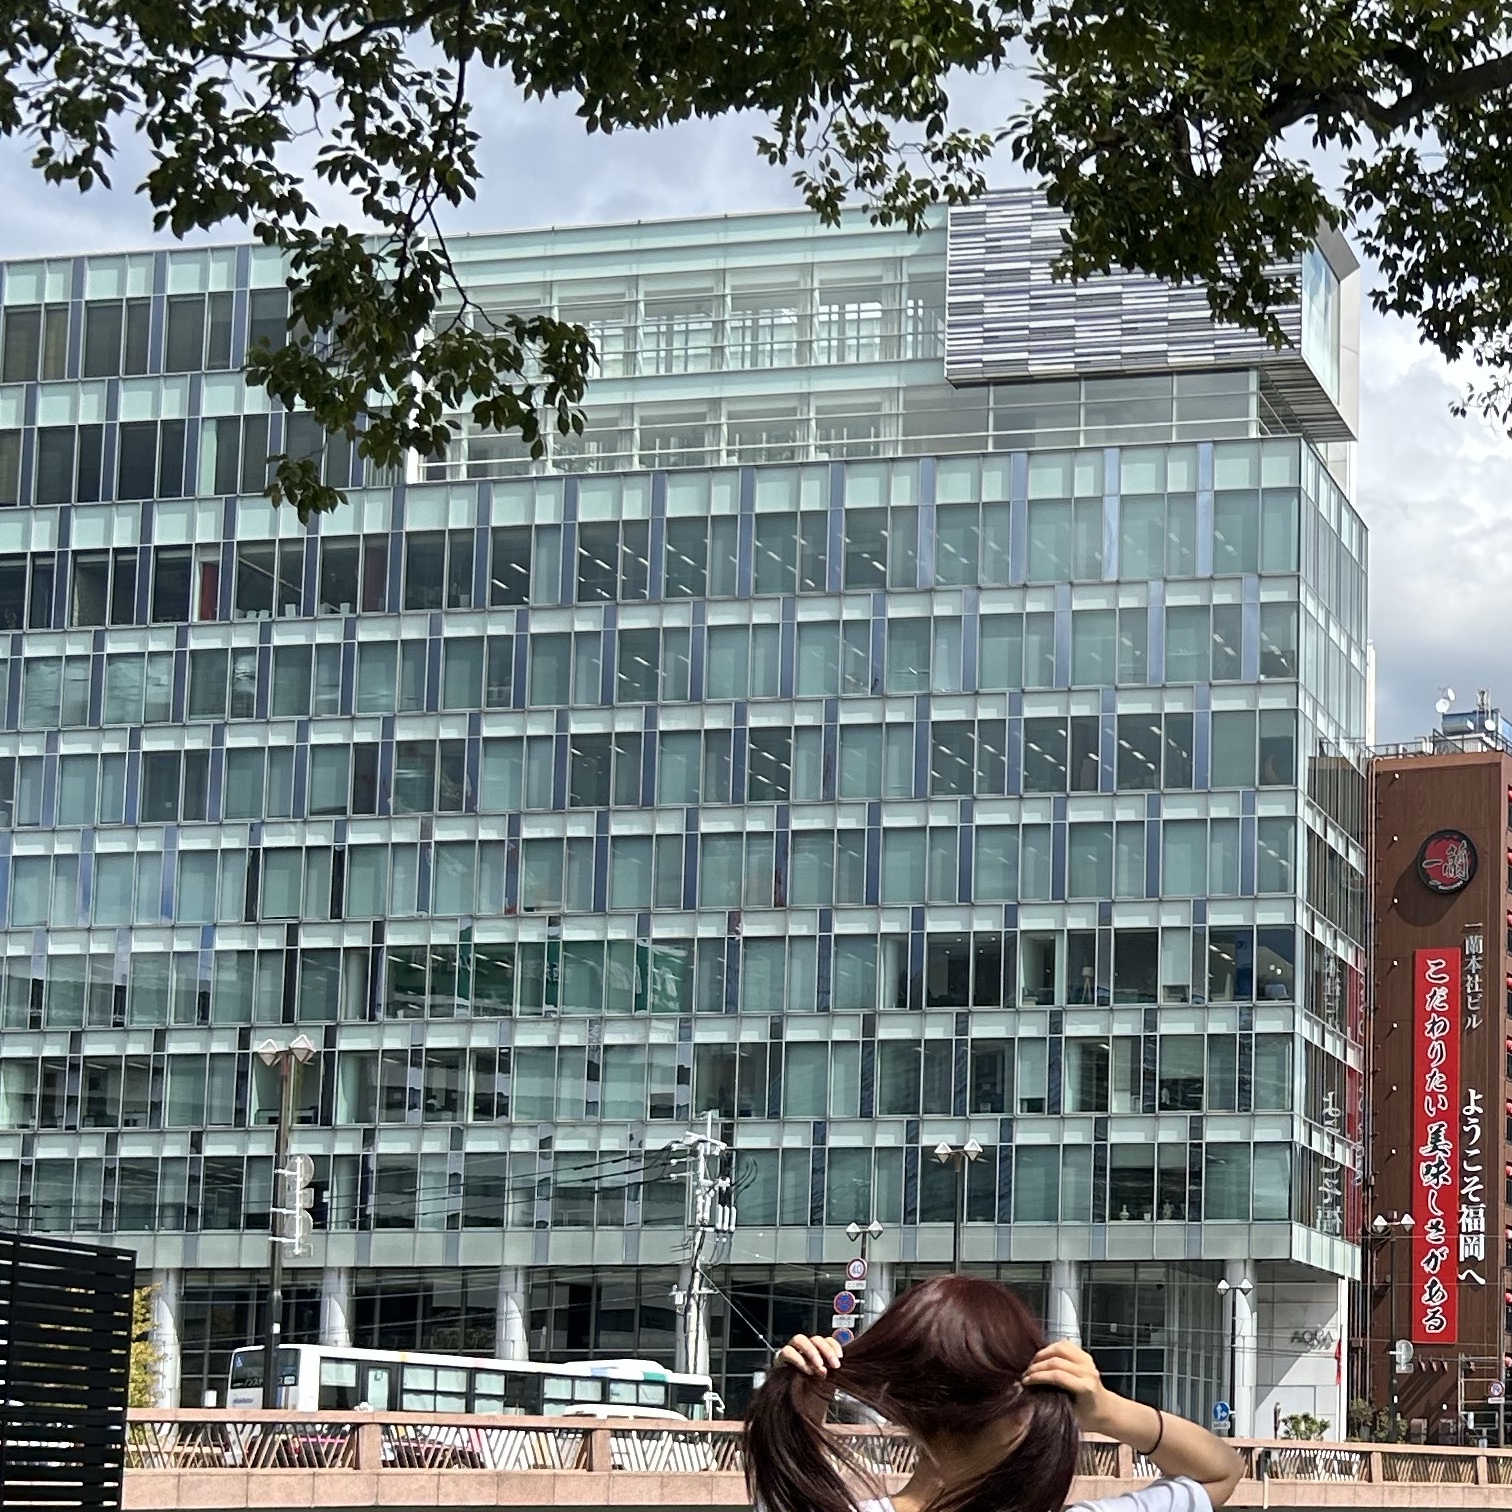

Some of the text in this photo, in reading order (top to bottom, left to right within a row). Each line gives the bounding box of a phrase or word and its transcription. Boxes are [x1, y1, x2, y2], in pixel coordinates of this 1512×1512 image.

[1464, 922, 1484, 1030] 一蘭本社ビル
[1420, 959, 1452, 1333] こだわりたい美味しさがある
[1458, 1089, 1486, 1285] ようこそ福岡へ
